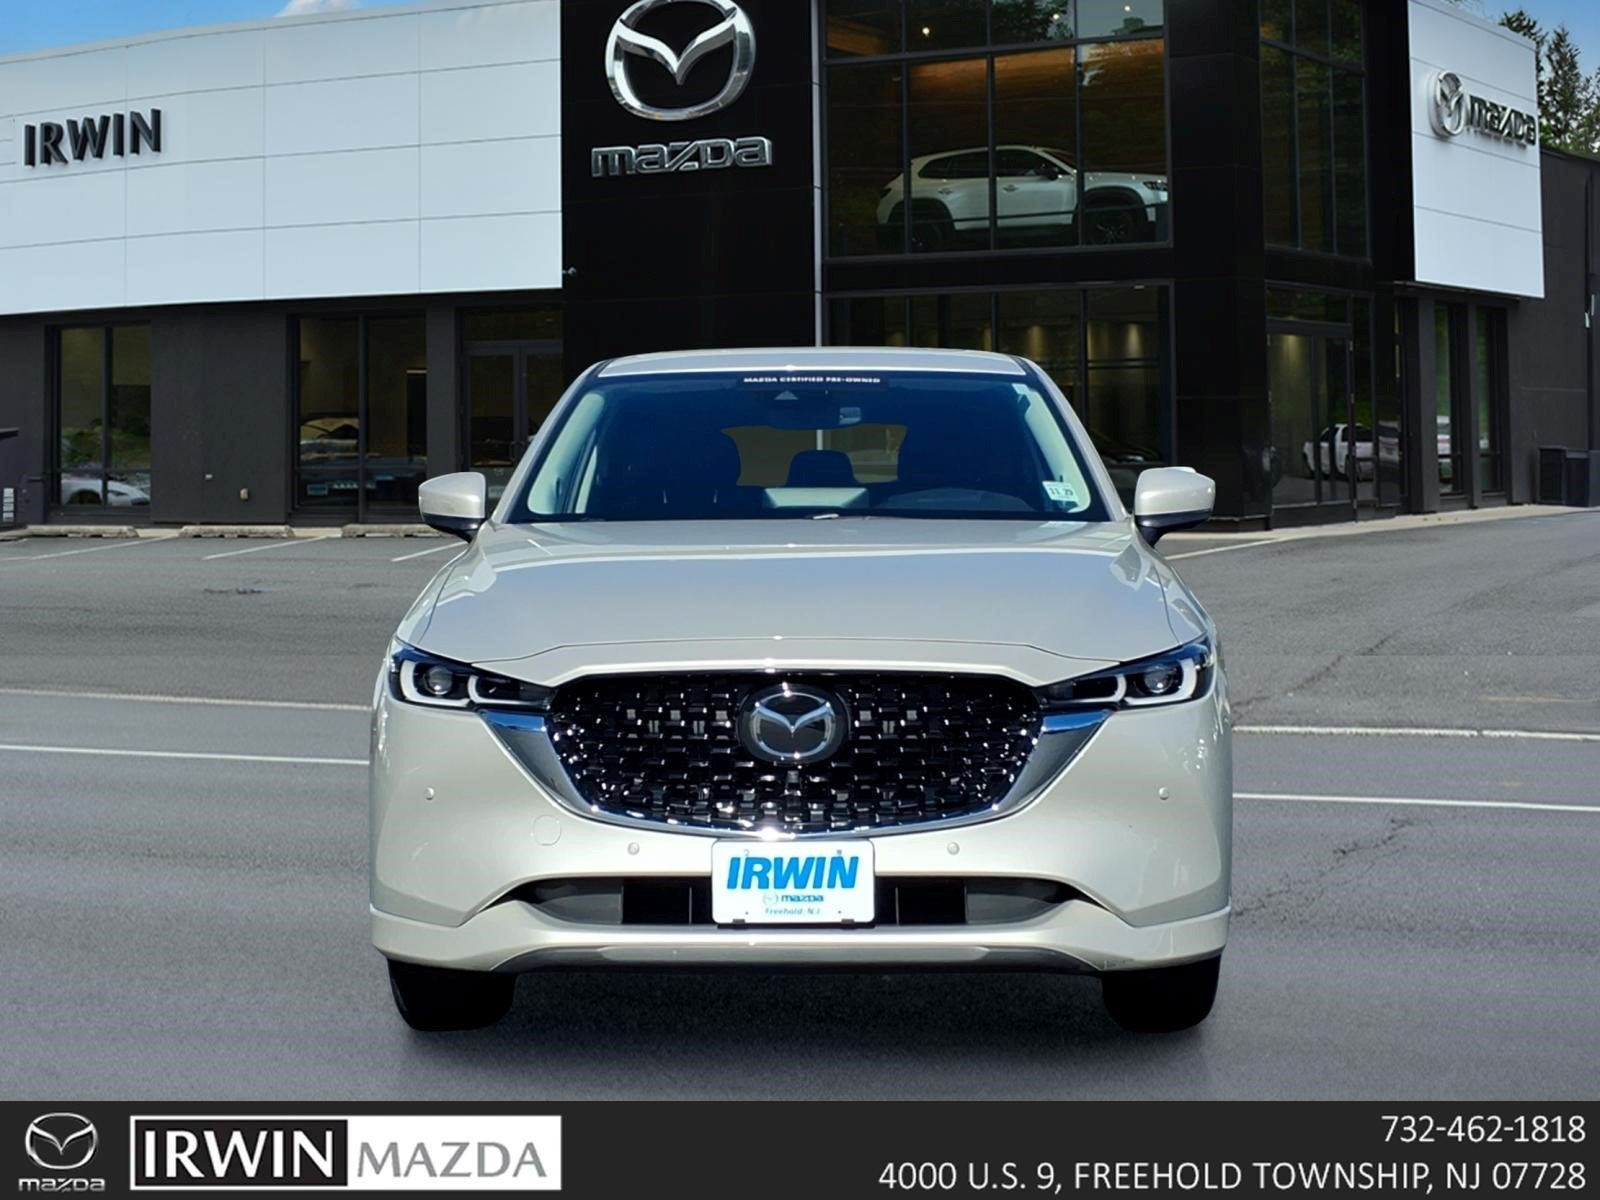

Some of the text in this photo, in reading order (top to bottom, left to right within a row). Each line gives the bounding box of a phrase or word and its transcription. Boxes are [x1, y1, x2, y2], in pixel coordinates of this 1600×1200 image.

[24, 108, 162, 168] IRWIN
[825, 376, 881, 384] PRE-OWNED
[727, 856, 859, 889] IRWIN
